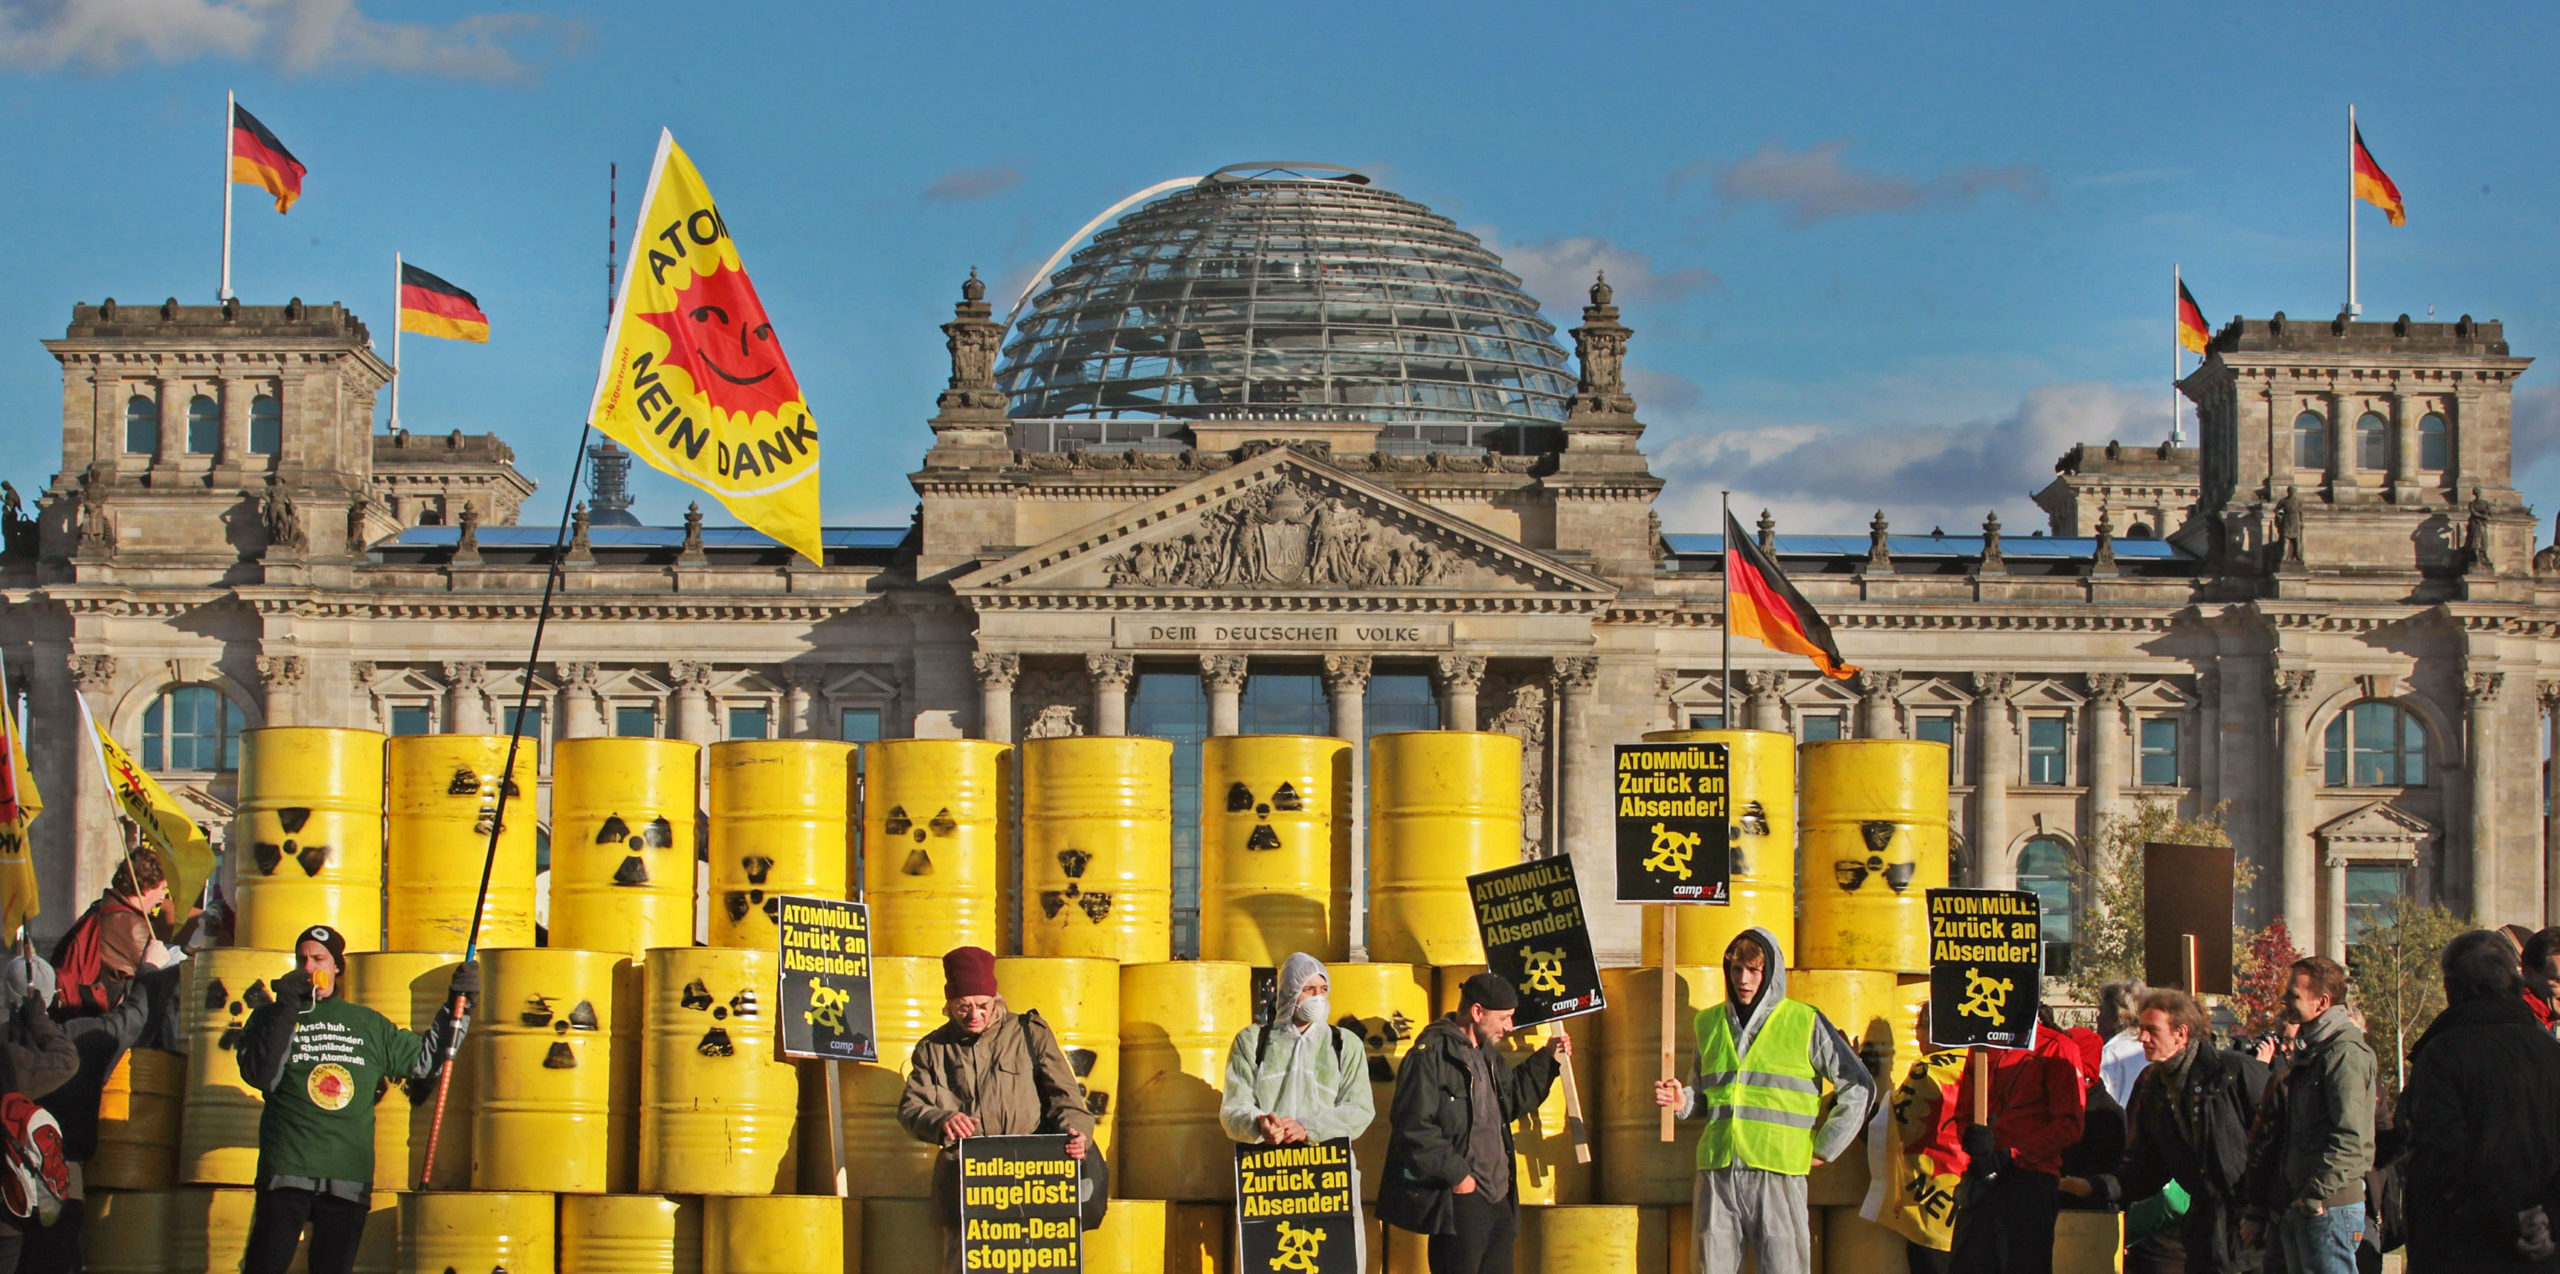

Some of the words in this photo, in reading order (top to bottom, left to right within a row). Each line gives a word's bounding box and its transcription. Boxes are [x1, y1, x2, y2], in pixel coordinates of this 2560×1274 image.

[632, 352, 710, 460] NEIN
[718, 413, 818, 480] DANK
[1150, 626, 1196, 641] DEM
[1215, 626, 1337, 641] DEUTSCHEN
[1357, 626, 1419, 641] VOLKE
[1618, 747, 1725, 770] ATOMMÜLL:
[1619, 772, 1693, 794] Zurück
[1699, 776, 1725, 794] an
[1619, 796, 1725, 817] Absender!
[1475, 864, 1571, 901] ATOMMÜLL:
[1479, 891, 1548, 925] Zurück
[1552, 887, 1576, 907] an
[1932, 893, 2037, 915] ATOMMÜLL:
[783, 904, 866, 931] ATOMMÜLL:
[1487, 905, 1582, 947] Absender!
[1933, 916, 2005, 939] Zurück
[2011, 922, 2037, 940] an
[783, 925, 841, 952] Zurück
[845, 936, 866, 954] an
[1934, 940, 2037, 963] Absender!
[784, 949, 867, 977] Absender!
[299, 1021, 327, 1032] Arsch
[327, 1022, 345, 1032] huh
[300, 1042, 353, 1053] Rheinländer
[965, 1157, 1076, 1179] Endlagerung
[1241, 1143, 1347, 1169] ATOMMÜLL:
[1241, 1168, 1316, 1194] Zurück
[1321, 1170, 1348, 1189] an
[966, 1179, 1076, 1210] ungelöst:
[1243, 1190, 1349, 1217] Absender!
[966, 1217, 1076, 1240] Atom-Deal
[967, 1242, 1077, 1274] stoppen!
